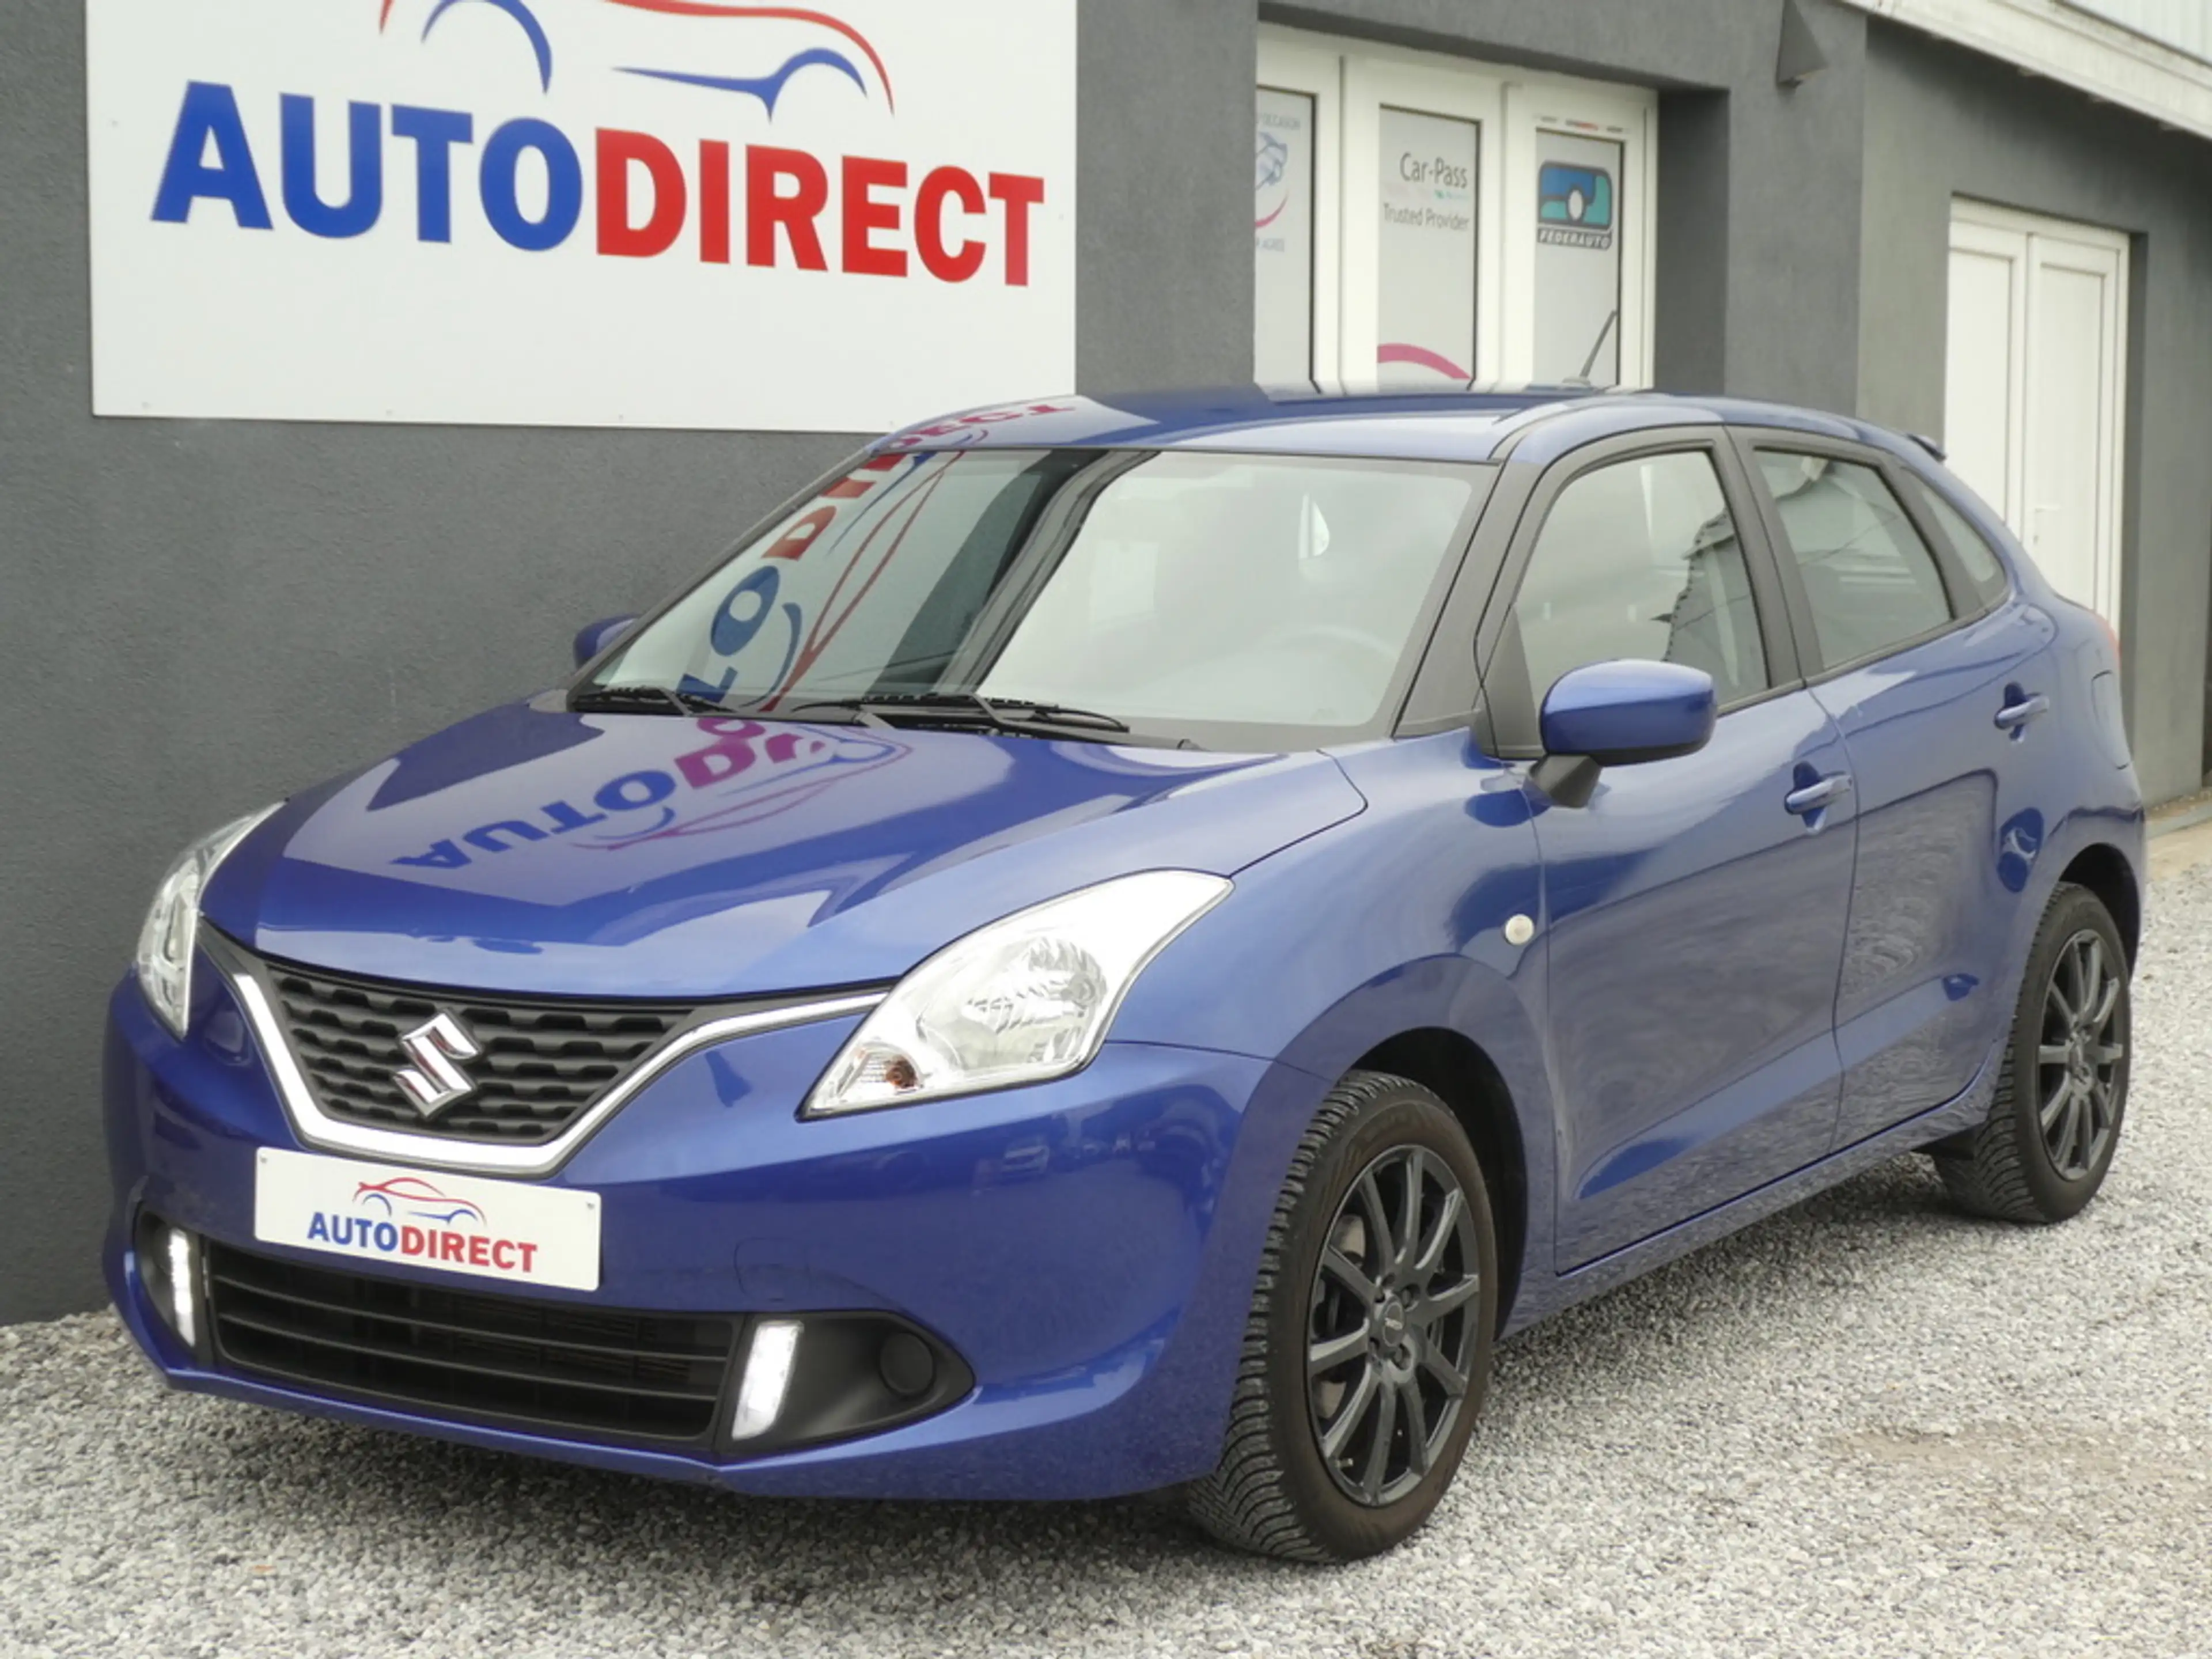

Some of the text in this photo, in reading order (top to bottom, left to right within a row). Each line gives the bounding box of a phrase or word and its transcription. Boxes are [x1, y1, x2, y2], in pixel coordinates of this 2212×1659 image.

[154, 84, 1043, 285] AUTODIRECT
[1399, 151, 1468, 189] Car-Pass
[1384, 202, 1470, 230] Trusted Provider
[1539, 229, 1611, 249] FEDERAUTO
[308, 1211, 538, 1273] AUTODIRECT
